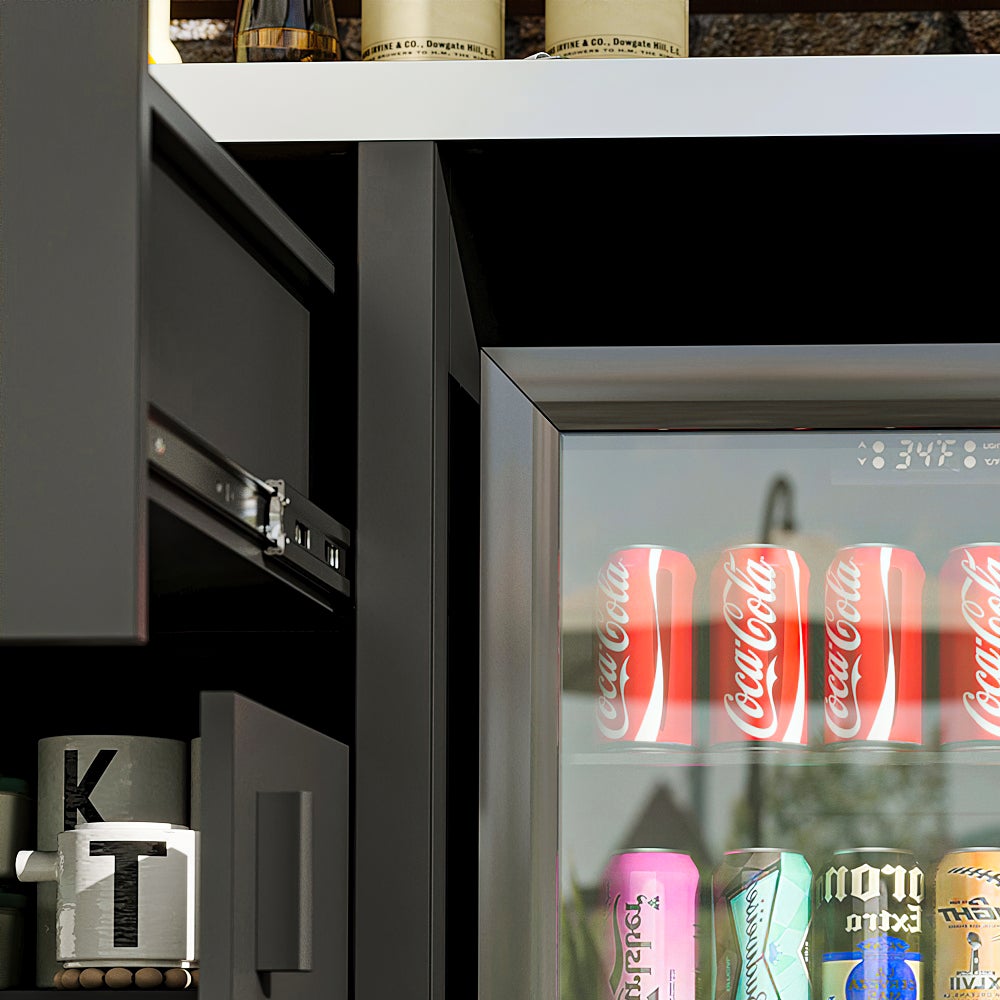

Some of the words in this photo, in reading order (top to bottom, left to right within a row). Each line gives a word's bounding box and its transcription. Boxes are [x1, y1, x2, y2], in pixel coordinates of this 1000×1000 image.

[395, 41, 402, 49] &
[427, 39, 465, 50] Dowgate
[582, 39, 589, 47] &
[613, 38, 651, 49] Dowgate
[64, 749, 118, 831] K
[89, 840, 168, 948] T
